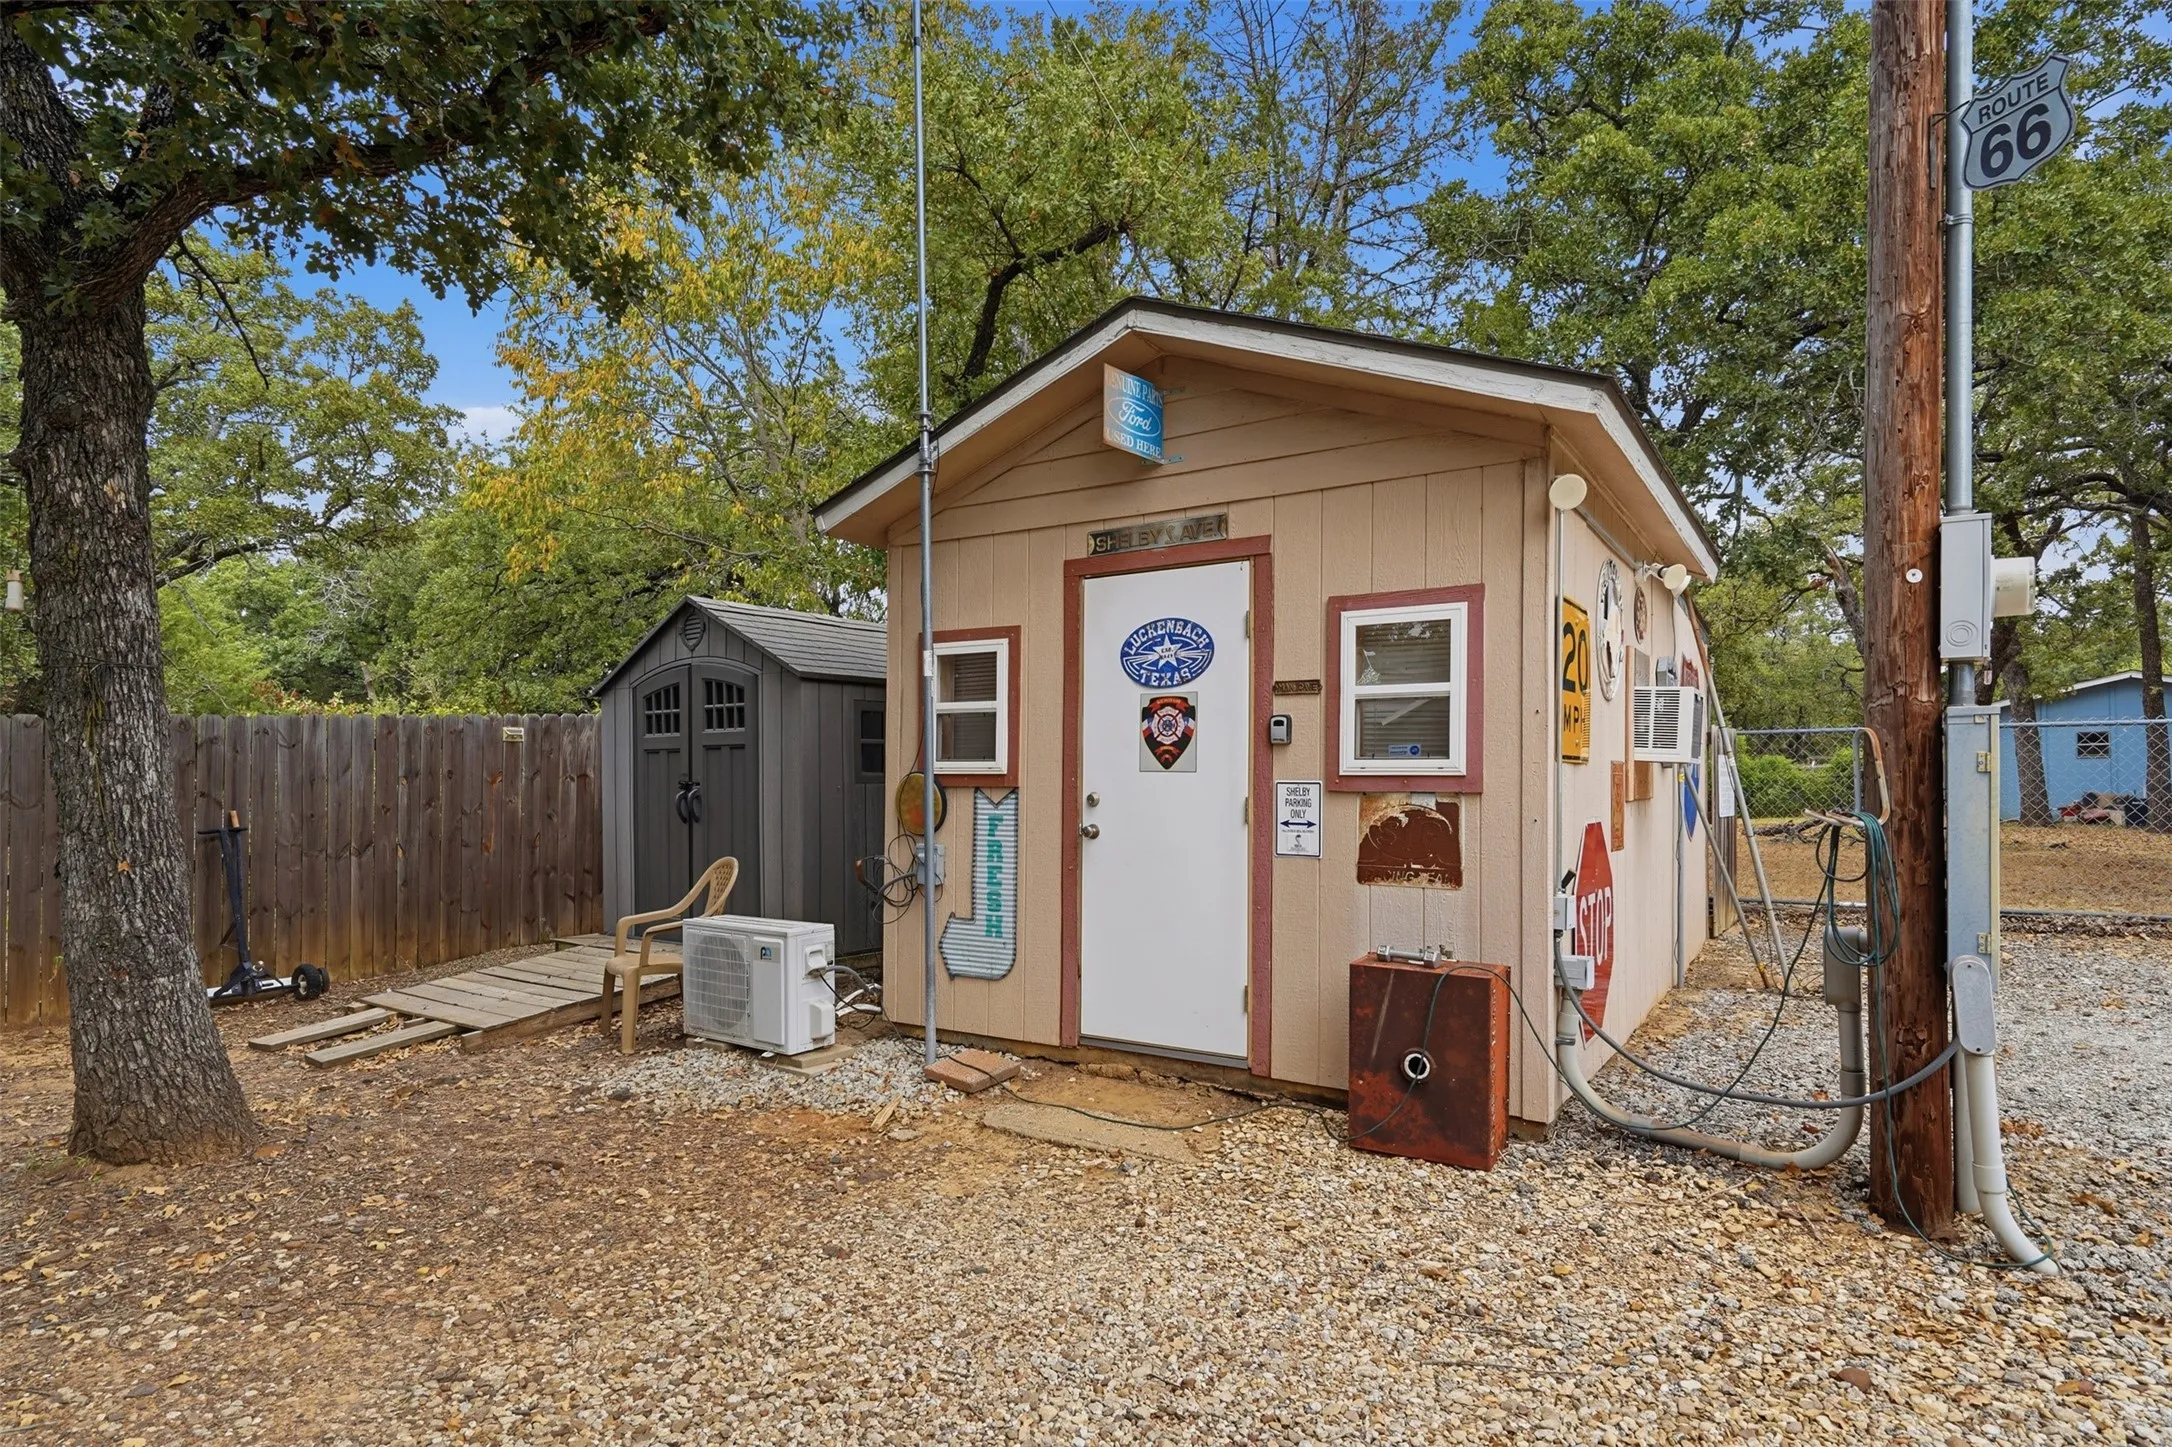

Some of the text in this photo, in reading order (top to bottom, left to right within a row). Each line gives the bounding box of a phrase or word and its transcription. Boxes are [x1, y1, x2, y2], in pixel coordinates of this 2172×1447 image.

[1979, 72, 2049, 124] ROUTE
[1980, 103, 2052, 179] 66
[1119, 401, 1153, 431] Ford
[1136, 438, 1161, 458] HERE
[1096, 527, 1162, 552] SHELBY
[1123, 619, 1211, 655] LUCKENBACH
[1563, 622, 1588, 696] 20
[1139, 667, 1192, 687] TEXAS
[1285, 797, 1312, 808] PARKING
[1286, 786, 1311, 797] SHELBY
[1290, 808, 1307, 819] ONLY
[985, 814, 1004, 938] FRESH
[1579, 886, 1612, 966] STOP
